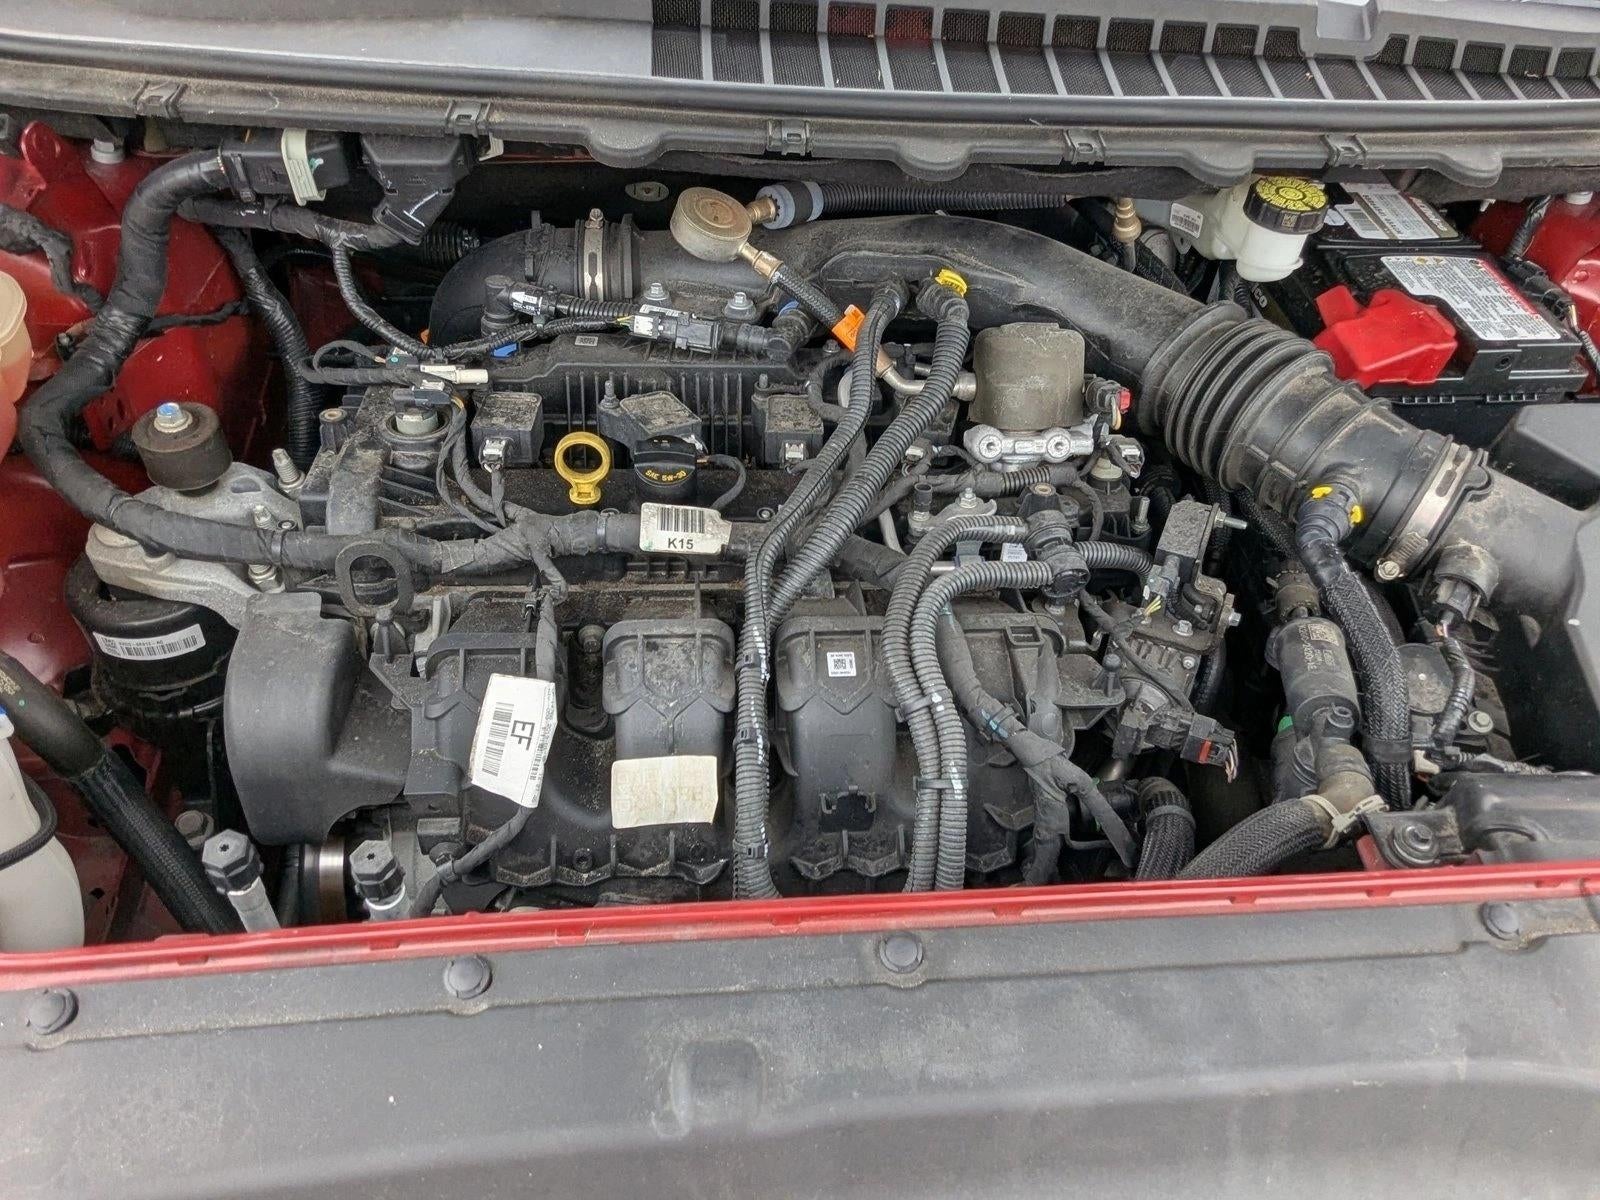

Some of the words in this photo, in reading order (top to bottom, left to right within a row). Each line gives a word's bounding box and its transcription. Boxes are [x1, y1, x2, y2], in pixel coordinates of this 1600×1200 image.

[645, 470, 660, 480] SAE
[667, 538, 694, 550] K15
[510, 720, 536, 751] EF
